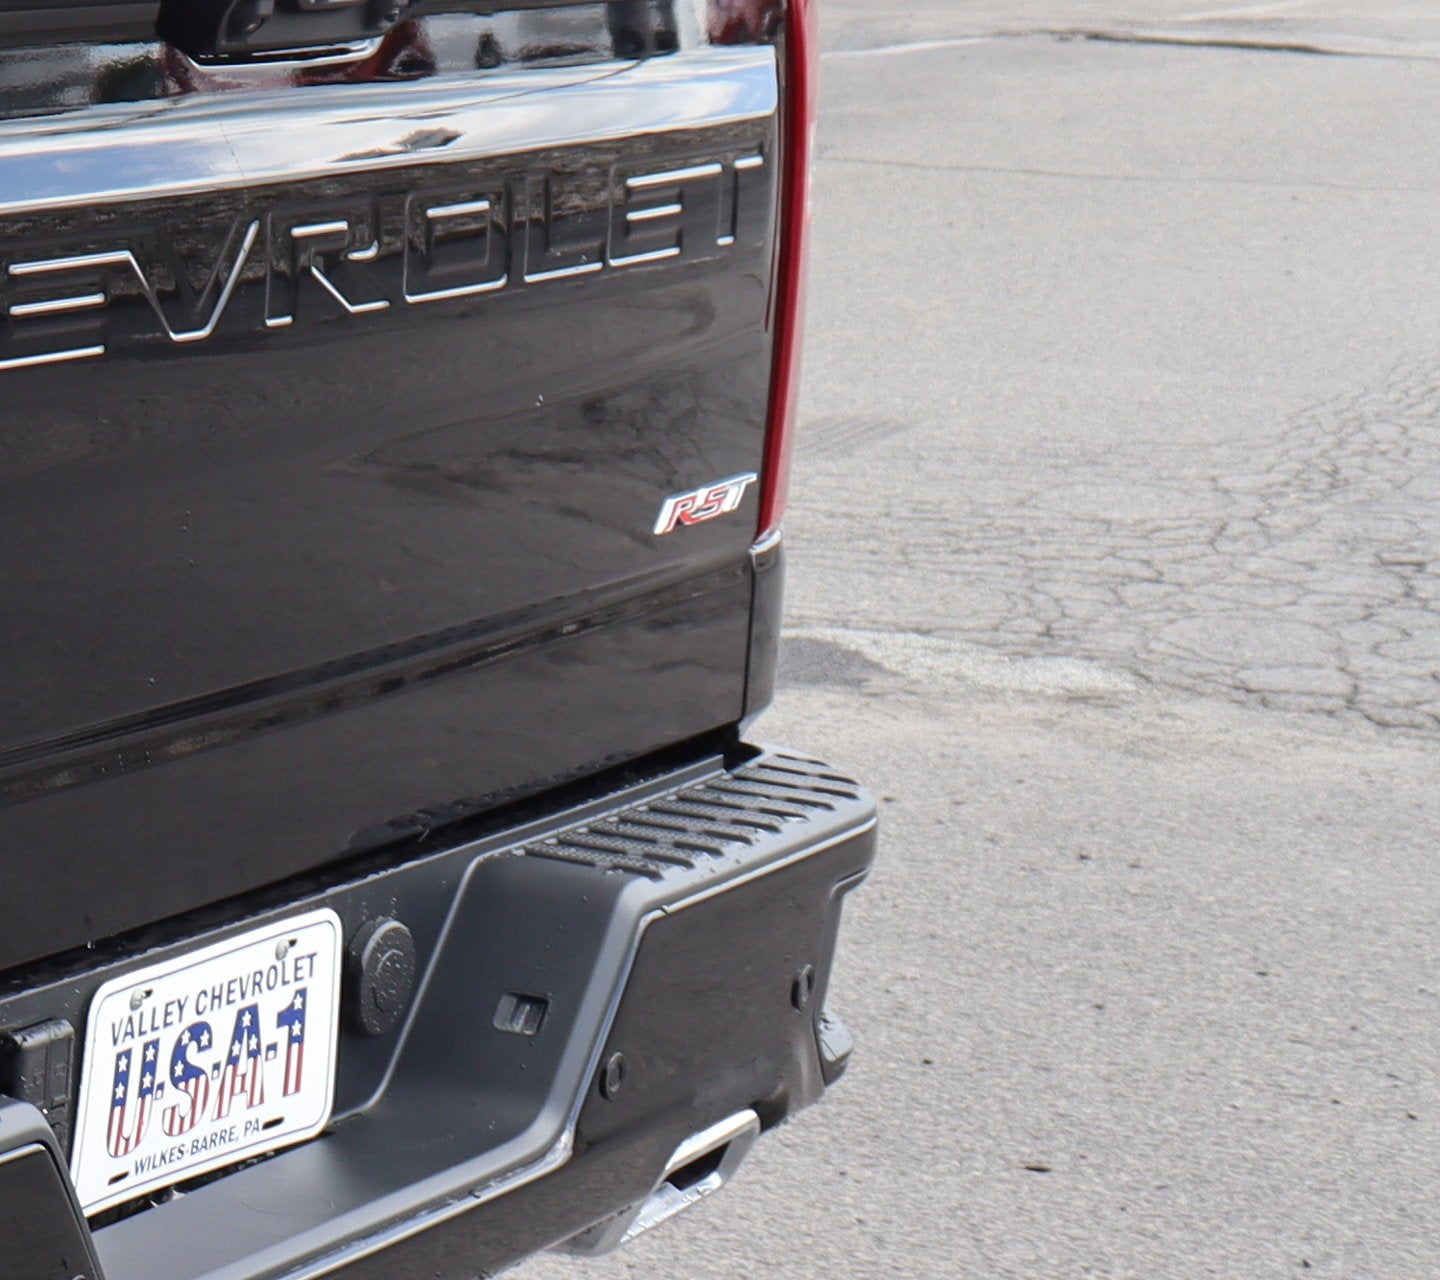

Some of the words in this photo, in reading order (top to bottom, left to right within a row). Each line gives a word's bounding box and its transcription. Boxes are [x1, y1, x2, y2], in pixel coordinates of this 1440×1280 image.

[654, 471, 757, 535] RST
[111, 995, 189, 1047] VALLEY
[195, 952, 318, 1017] CHEVROLET
[134, 1130, 239, 1176] WILKES-BARRE,
[244, 1117, 261, 1138] PA
